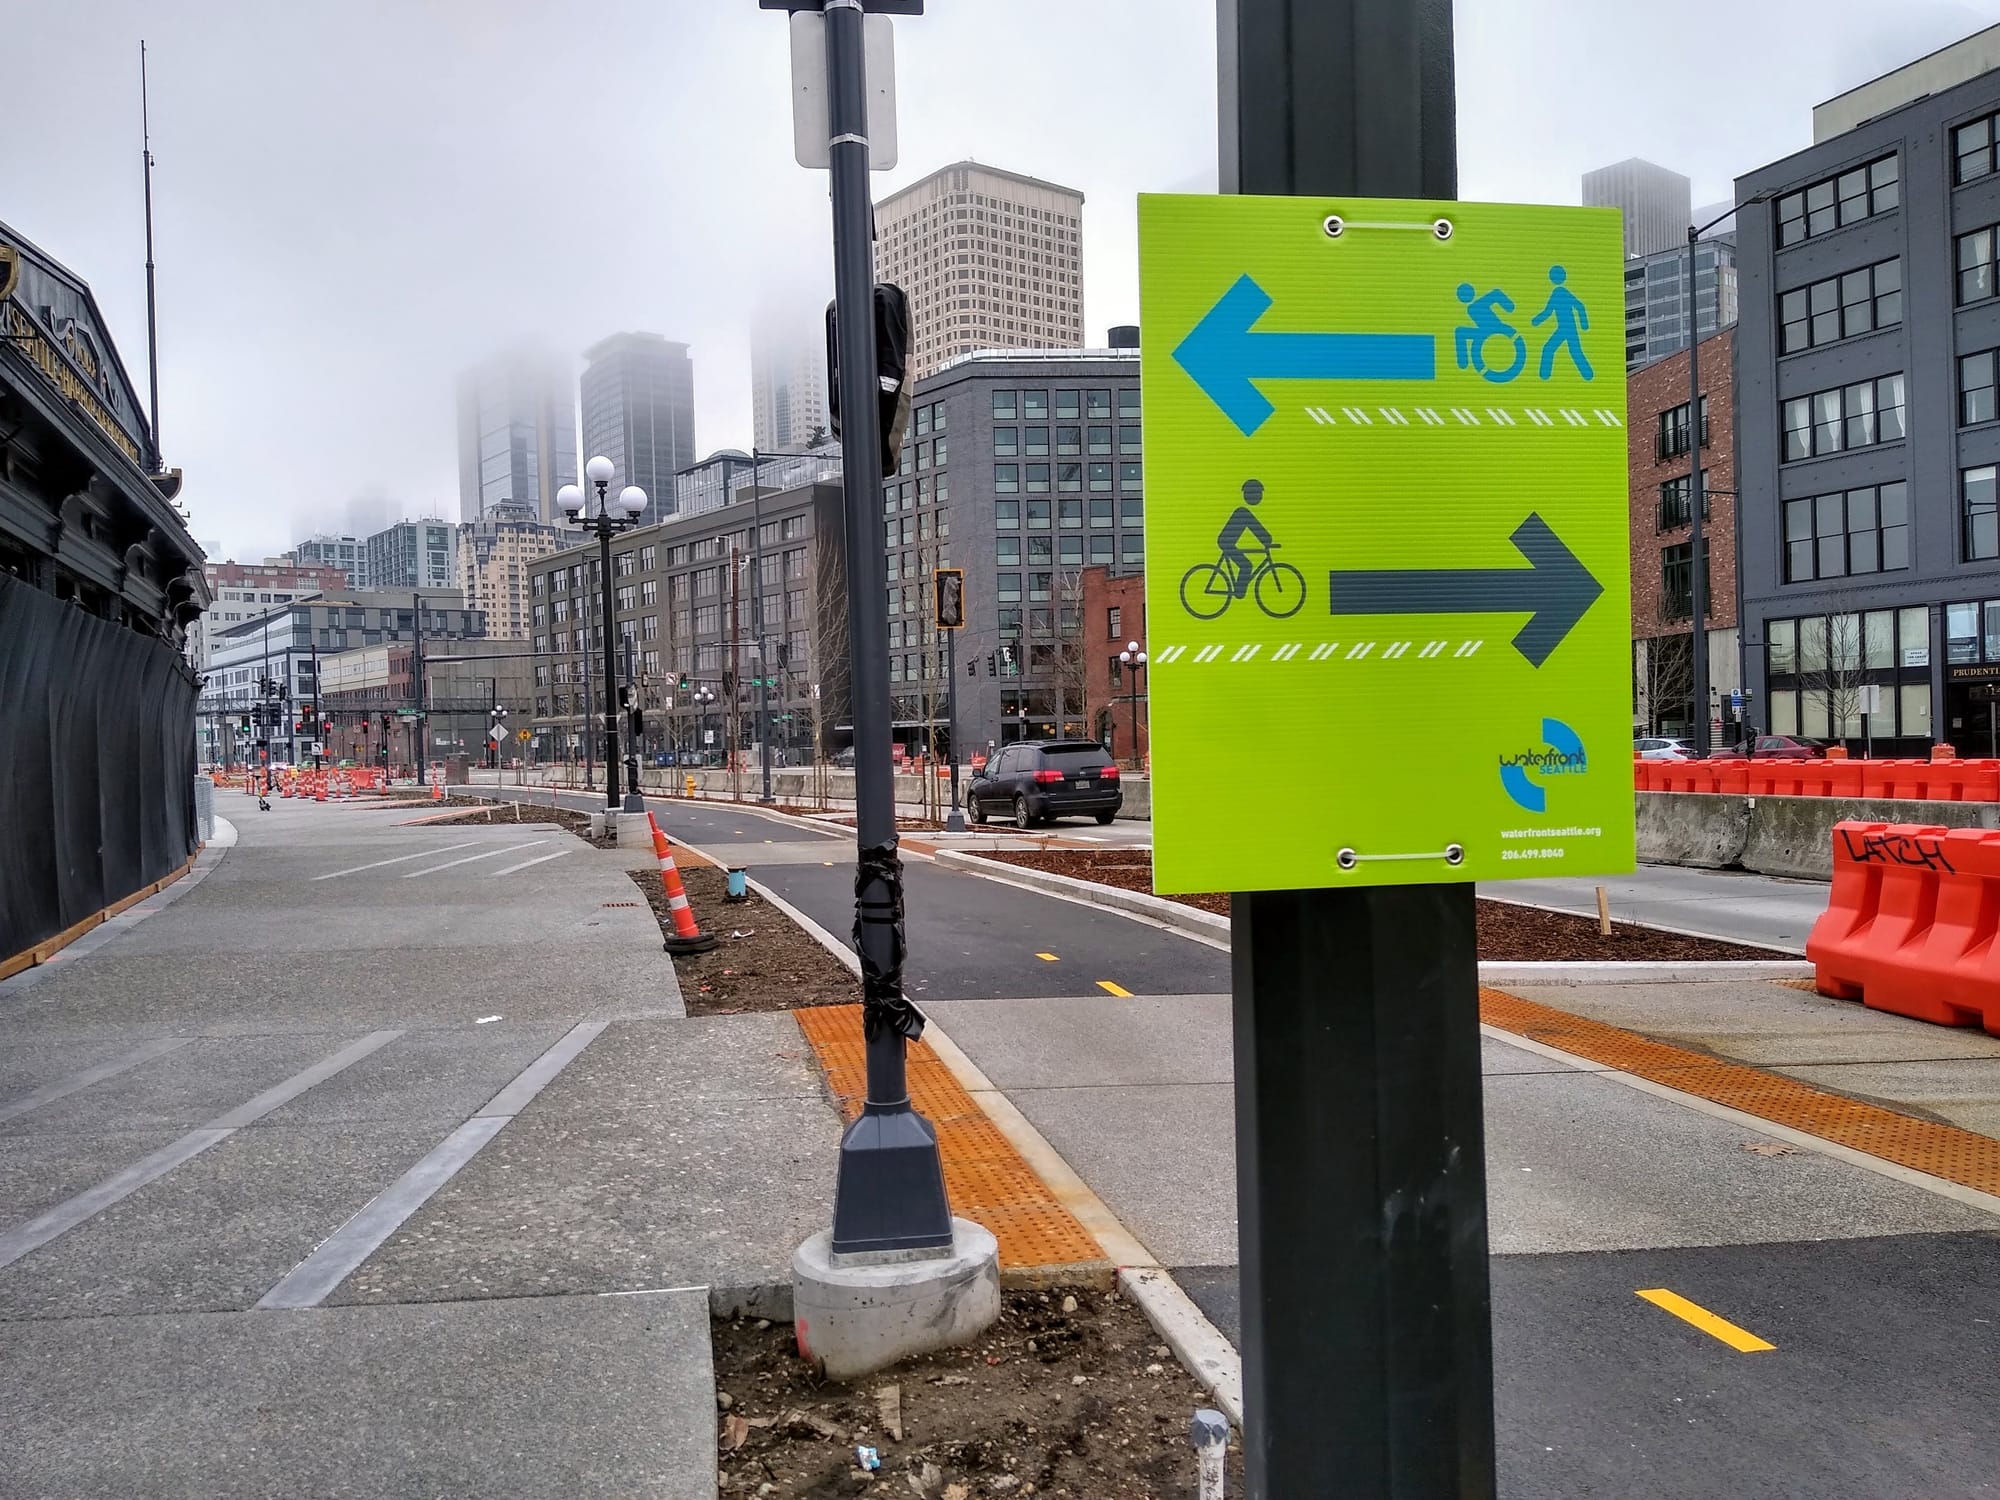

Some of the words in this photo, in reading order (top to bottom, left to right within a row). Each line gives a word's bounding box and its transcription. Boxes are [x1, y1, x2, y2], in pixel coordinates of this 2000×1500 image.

[12, 307, 60, 386] SEATTLE
[1953, 667, 2000, 677] PRUDENTI
[1499, 748, 1585, 766] waterfront
[1539, 765, 1587, 774] SEATTLE
[1501, 826, 1601, 838] waterfrontseattle.org
[1502, 848, 1564, 859] 206.499.8040
[1840, 829, 1956, 875] LATCH
